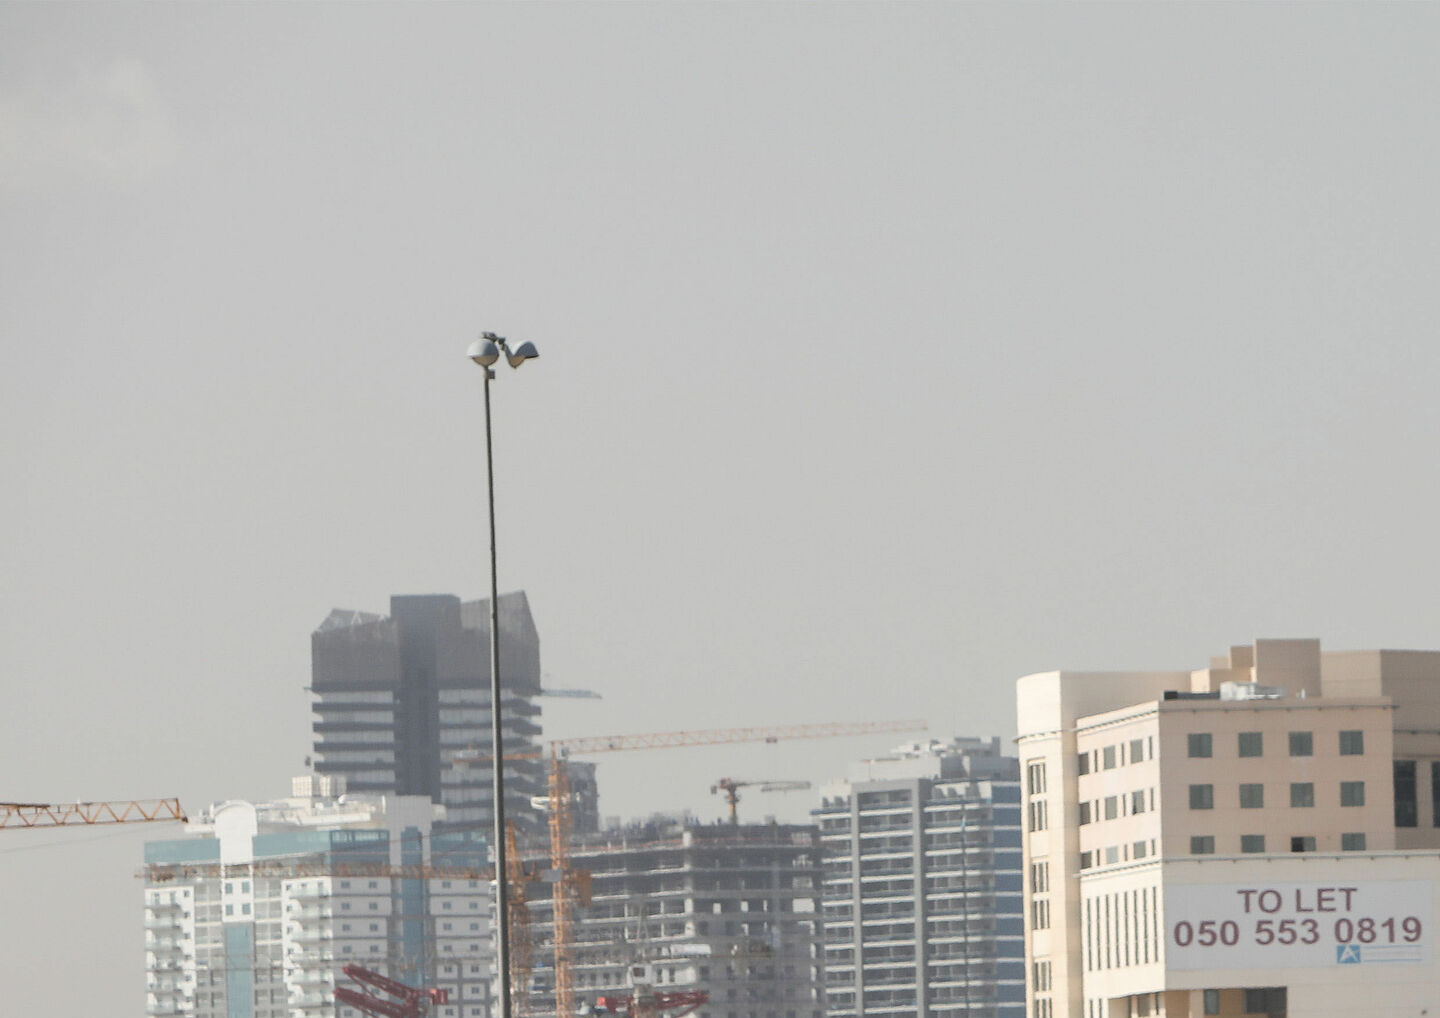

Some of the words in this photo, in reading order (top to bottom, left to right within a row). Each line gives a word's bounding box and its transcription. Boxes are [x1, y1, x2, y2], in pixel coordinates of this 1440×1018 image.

[1237, 889, 1282, 914] TO
[1295, 887, 1358, 913] LET
[1173, 919, 1240, 947] 050
[1254, 918, 1320, 946] 553
[1334, 916, 1423, 944] 0819
